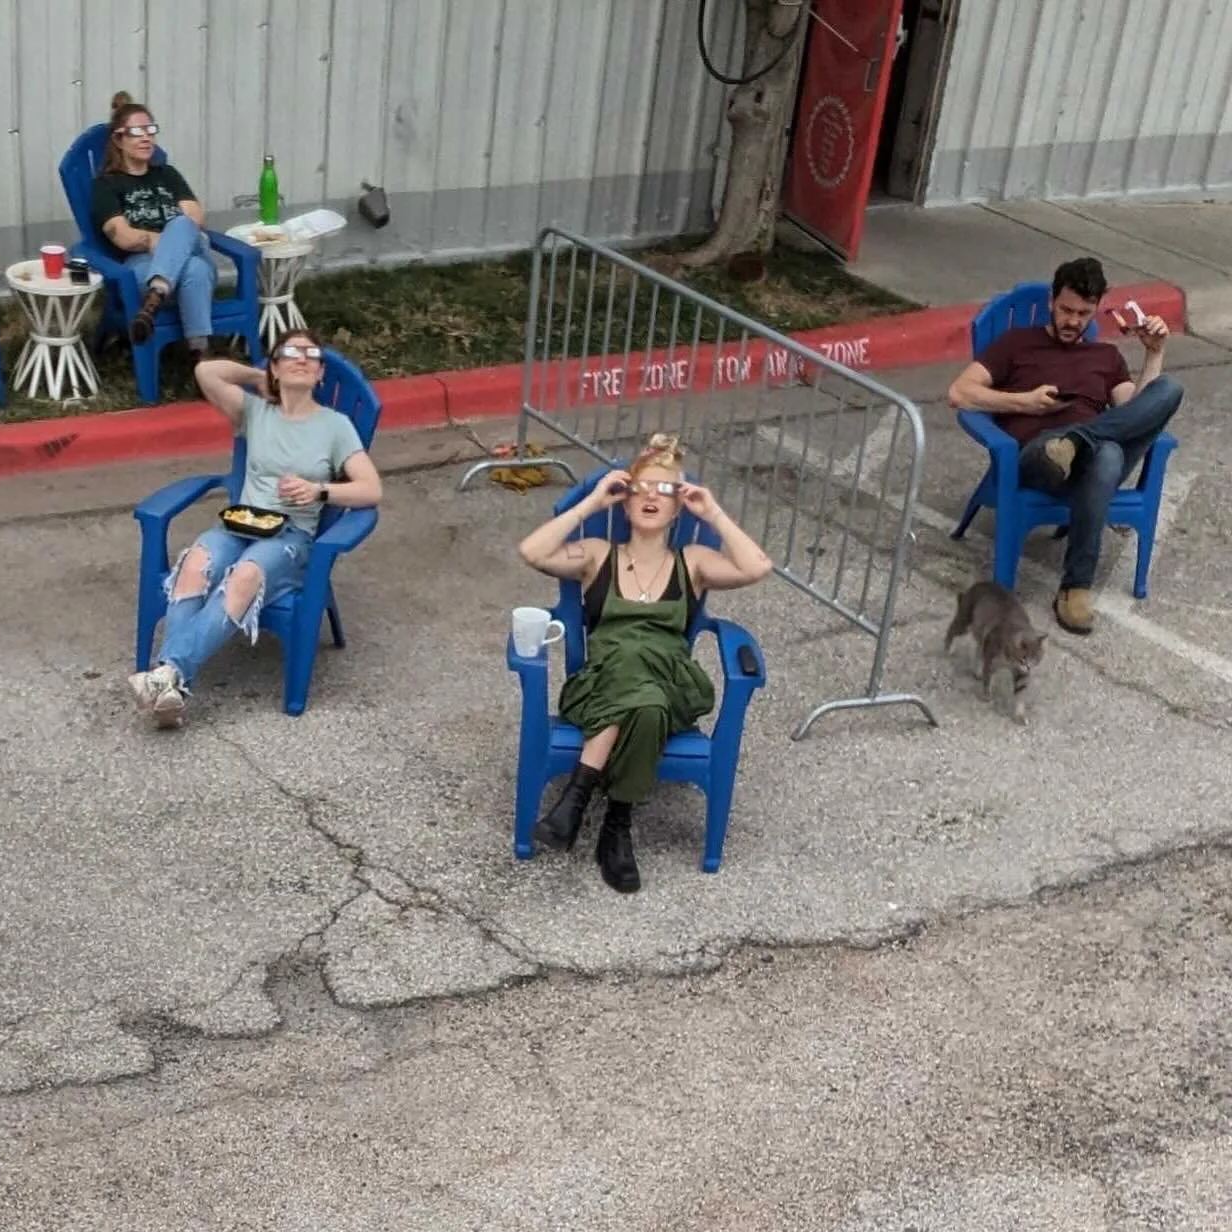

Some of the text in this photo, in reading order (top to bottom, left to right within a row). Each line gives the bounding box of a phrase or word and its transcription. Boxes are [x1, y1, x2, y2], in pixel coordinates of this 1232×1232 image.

[581, 367, 624, 398] FIRE
[639, 360, 689, 392] ZONE
[820, 337, 871, 366] ZONE
